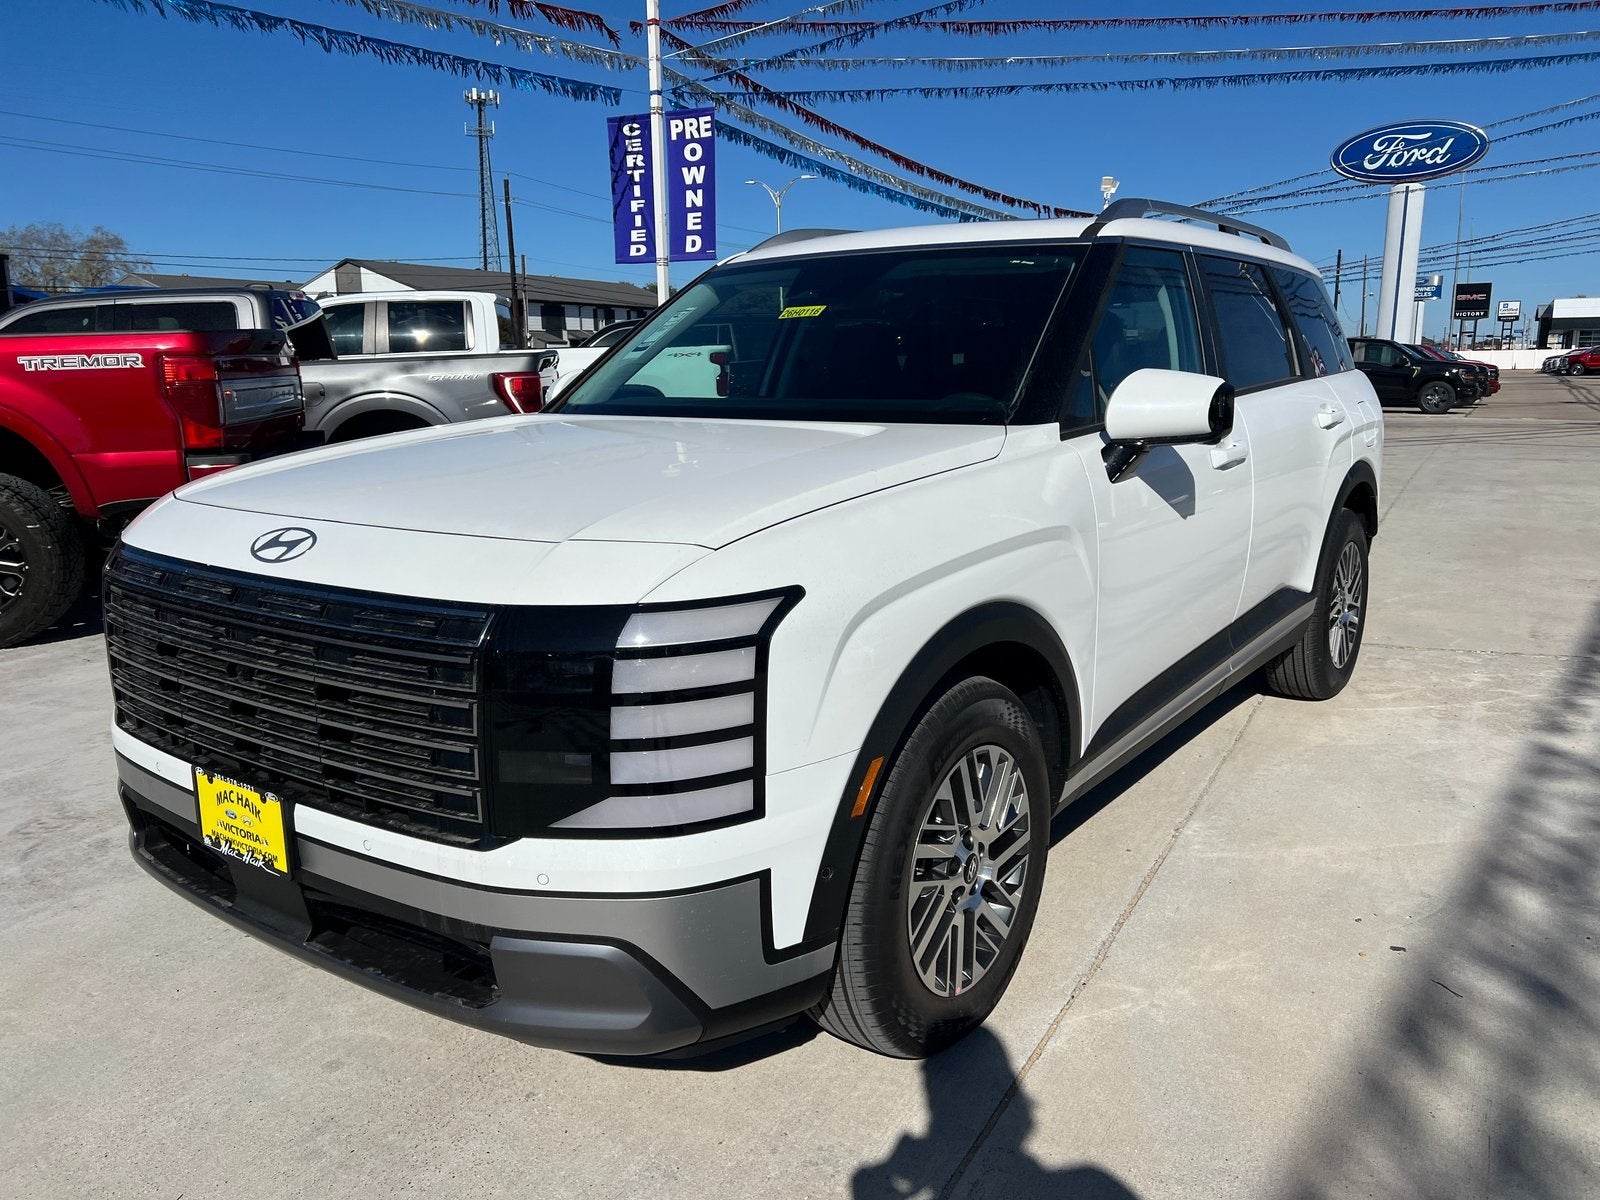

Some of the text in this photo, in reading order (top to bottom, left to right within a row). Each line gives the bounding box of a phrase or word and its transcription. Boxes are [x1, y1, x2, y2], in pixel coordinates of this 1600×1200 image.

[669, 115, 712, 141] PRE
[1363, 132, 1455, 170] Ford
[622, 123, 647, 257] CERTIFIED
[681, 142, 706, 253] OWNED
[17, 353, 146, 371] TREMOR
[216, 790, 235, 806] MAC
[236, 792, 262, 823] HAIK
